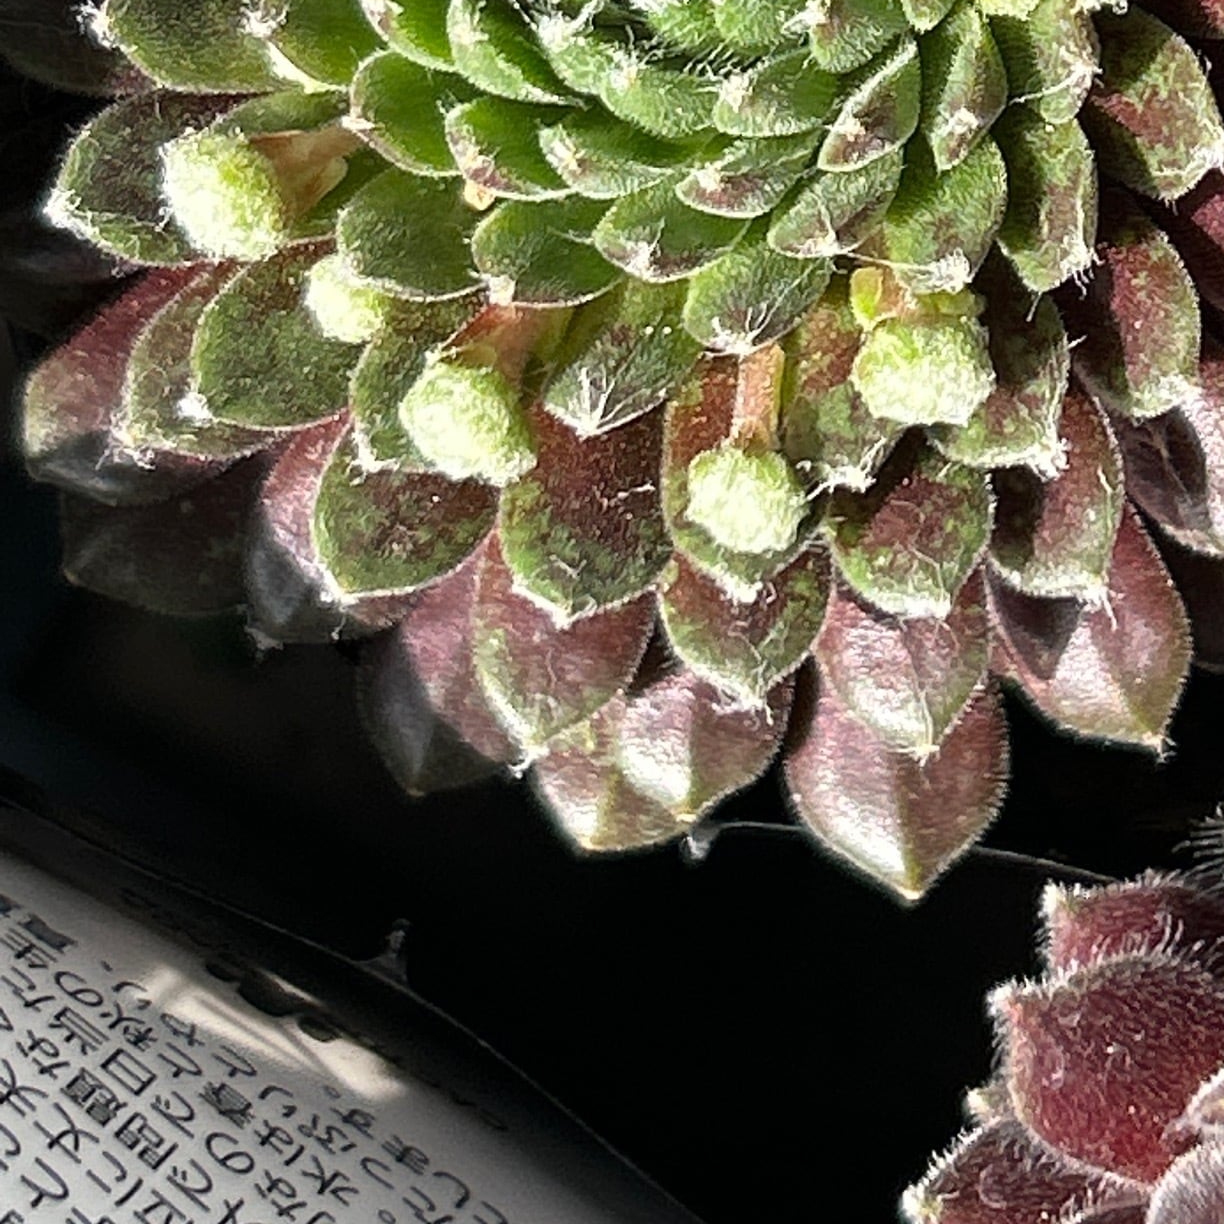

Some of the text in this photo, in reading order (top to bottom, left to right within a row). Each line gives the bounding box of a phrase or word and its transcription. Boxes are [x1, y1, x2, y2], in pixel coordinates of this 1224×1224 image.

[0, 966, 335, 1224] なので日当た
